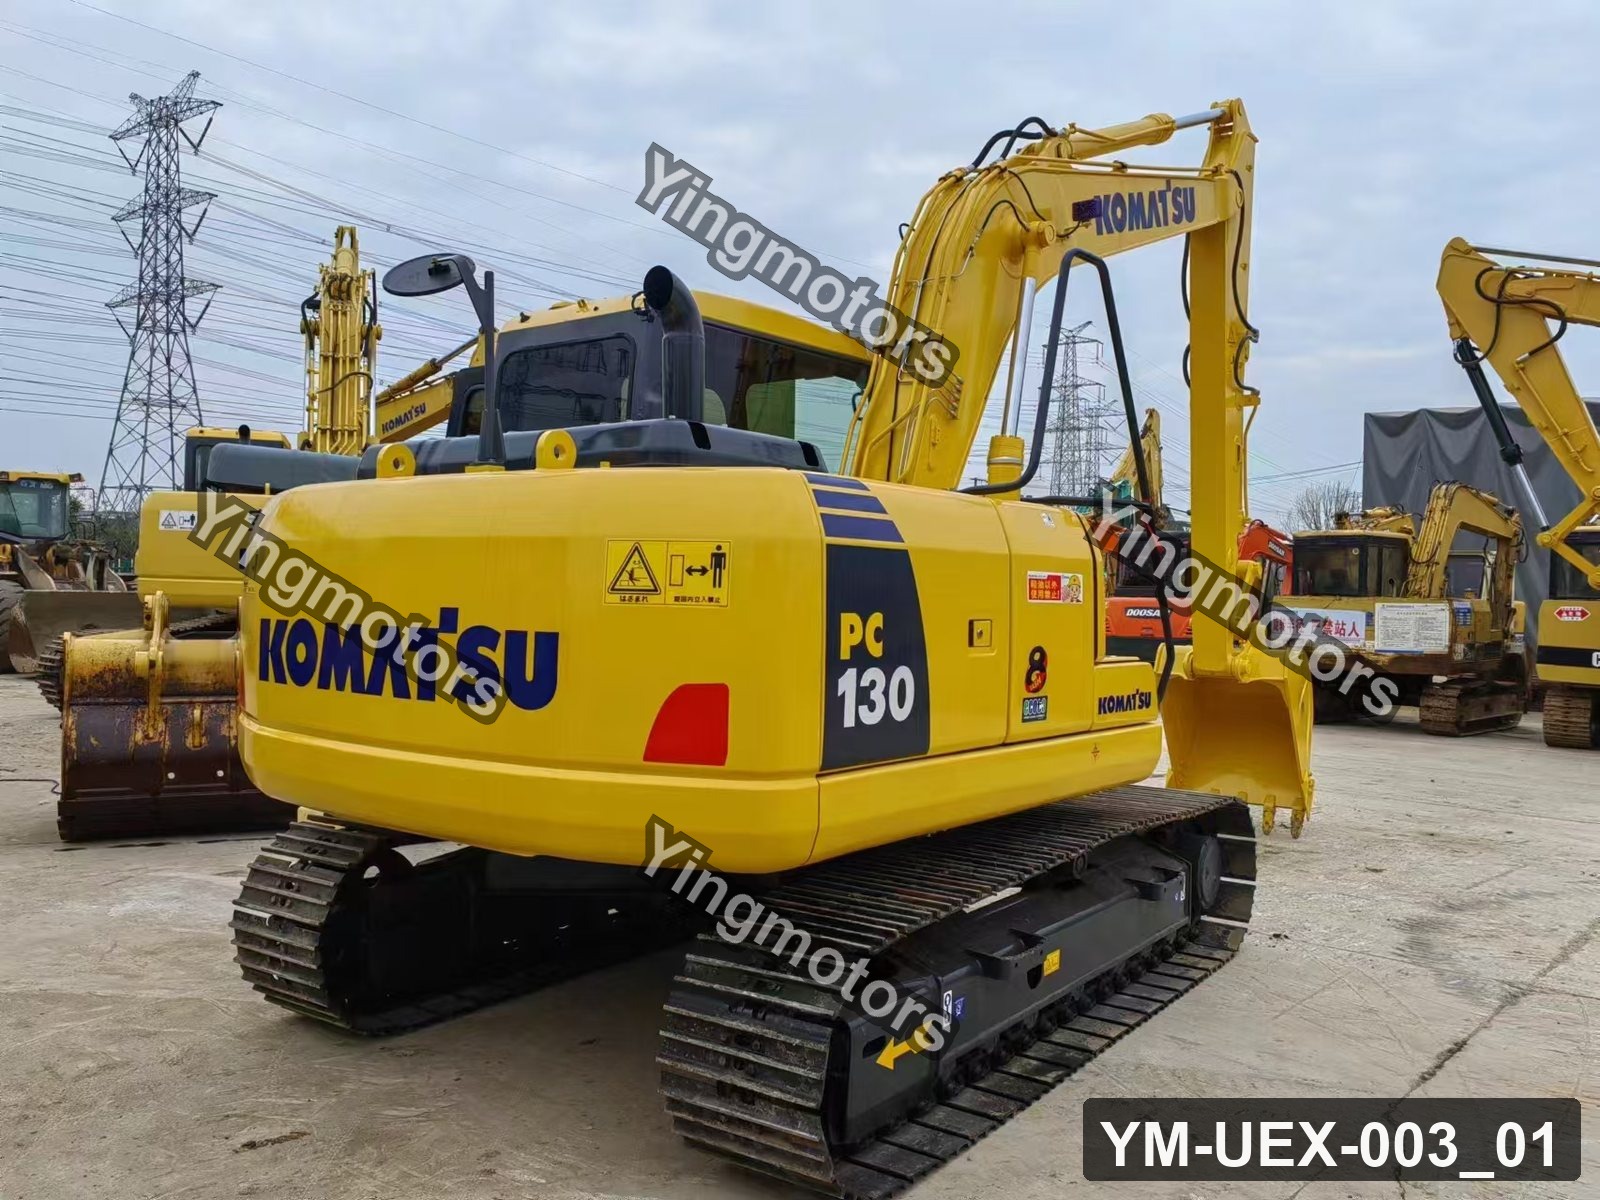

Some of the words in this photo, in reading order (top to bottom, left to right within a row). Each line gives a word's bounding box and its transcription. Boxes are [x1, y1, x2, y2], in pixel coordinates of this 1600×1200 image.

[1094, 179, 1196, 236] KOMATSU
[382, 401, 427, 434] KOMATSU
[840, 611, 884, 661] PC
[1126, 608, 1170, 617] DOOSA
[259, 607, 560, 711] KOMATSU
[837, 665, 915, 728] 130
[1097, 688, 1152, 715] KOMATSU
